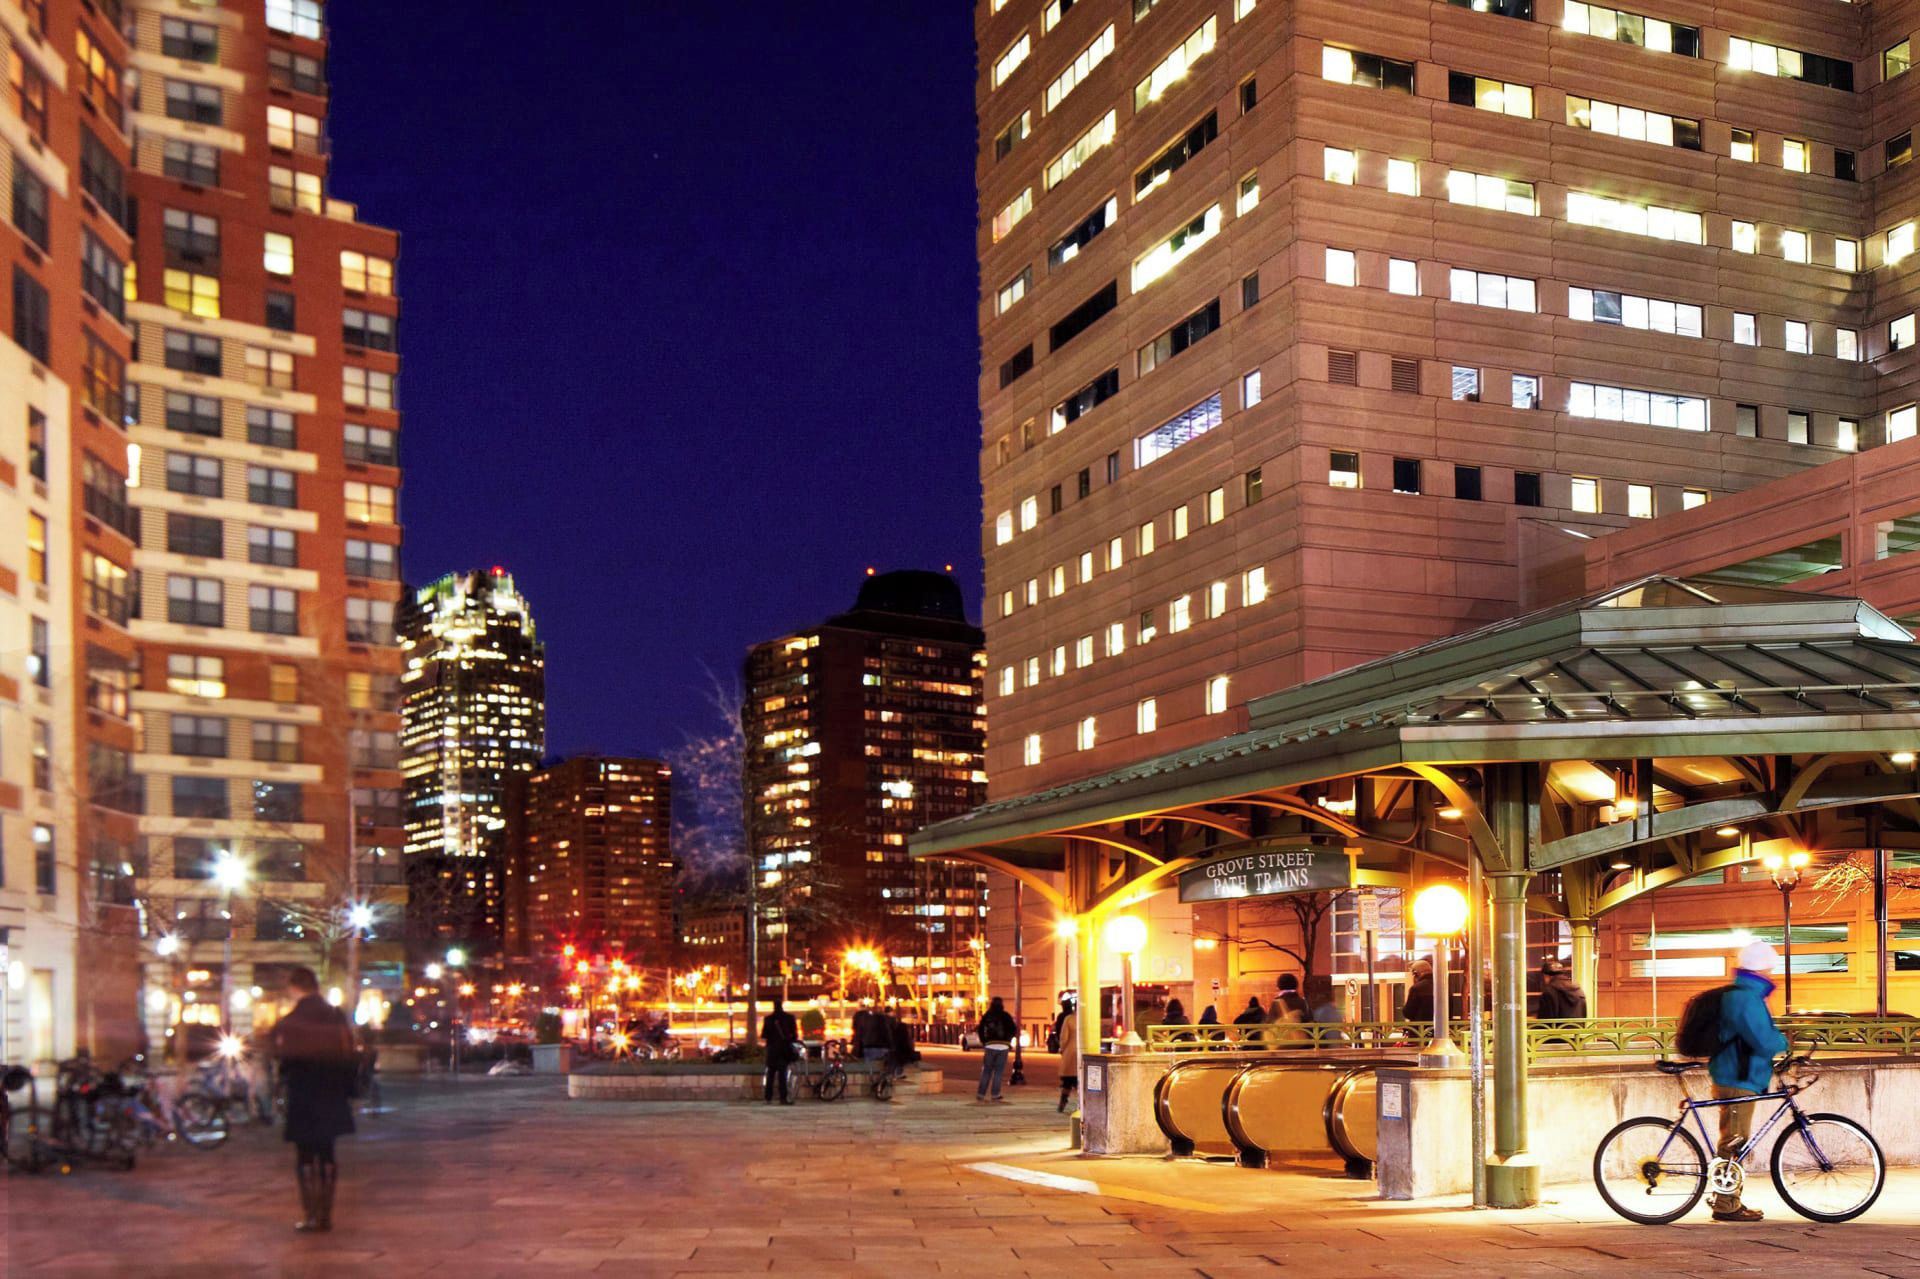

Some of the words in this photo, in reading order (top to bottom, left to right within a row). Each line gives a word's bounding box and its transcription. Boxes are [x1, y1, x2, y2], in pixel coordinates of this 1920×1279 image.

[1206, 857, 1254, 878] GROVE
[1259, 853, 1314, 868] STREET
[1213, 874, 1247, 895] PATH
[1255, 868, 1309, 891] TRAINS
